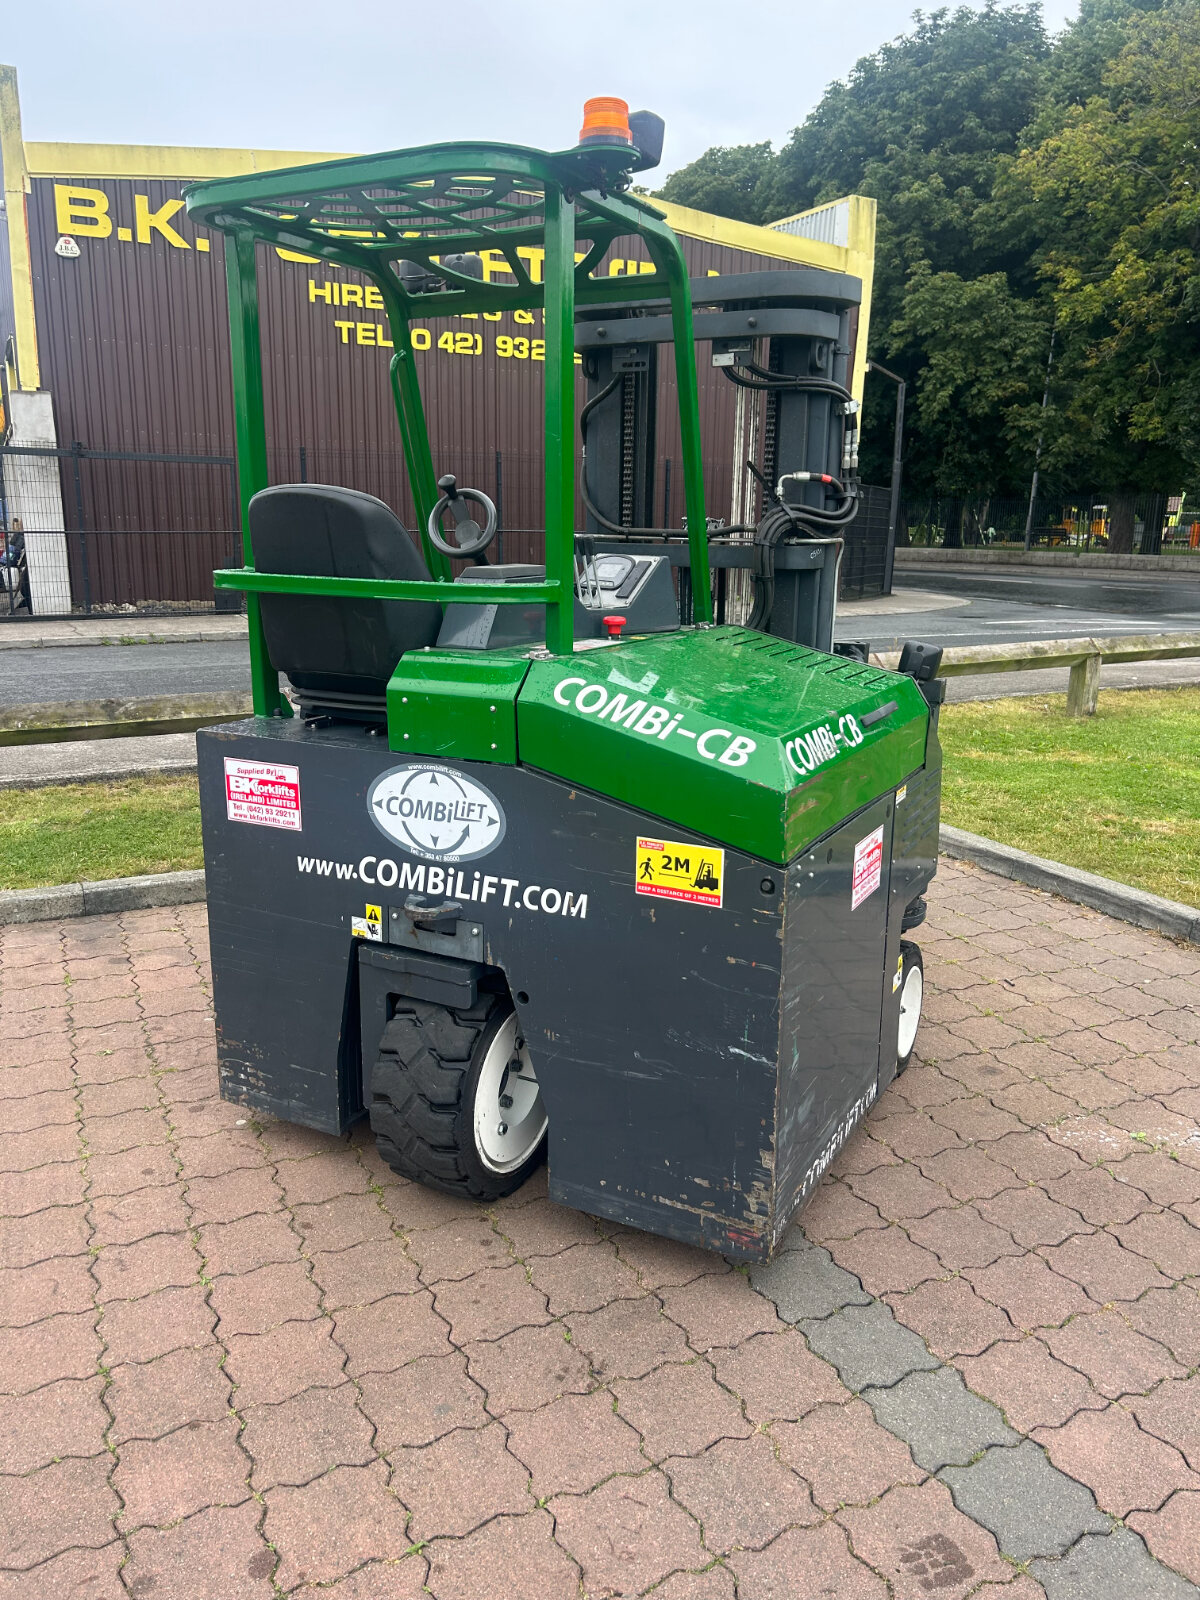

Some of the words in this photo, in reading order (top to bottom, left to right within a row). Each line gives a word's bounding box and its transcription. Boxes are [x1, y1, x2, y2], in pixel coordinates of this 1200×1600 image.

[54, 183, 210, 253] B.K.
[237, 767, 264, 775] Supplied
[230, 791, 265, 804] (IRELAND)
[266, 796, 297, 809] LIMITED
[233, 812, 296, 826] www.bkforklifts.com
[246, 805, 264, 815] (042)
[265, 807, 274, 815] 93
[275, 809, 296, 818] 29211
[661, 855, 690, 873] 2M
[297, 856, 589, 919] www.COMBiLiFT.COM
[657, 889, 683, 898] DISTANCE
[698, 895, 719, 904] METRES
